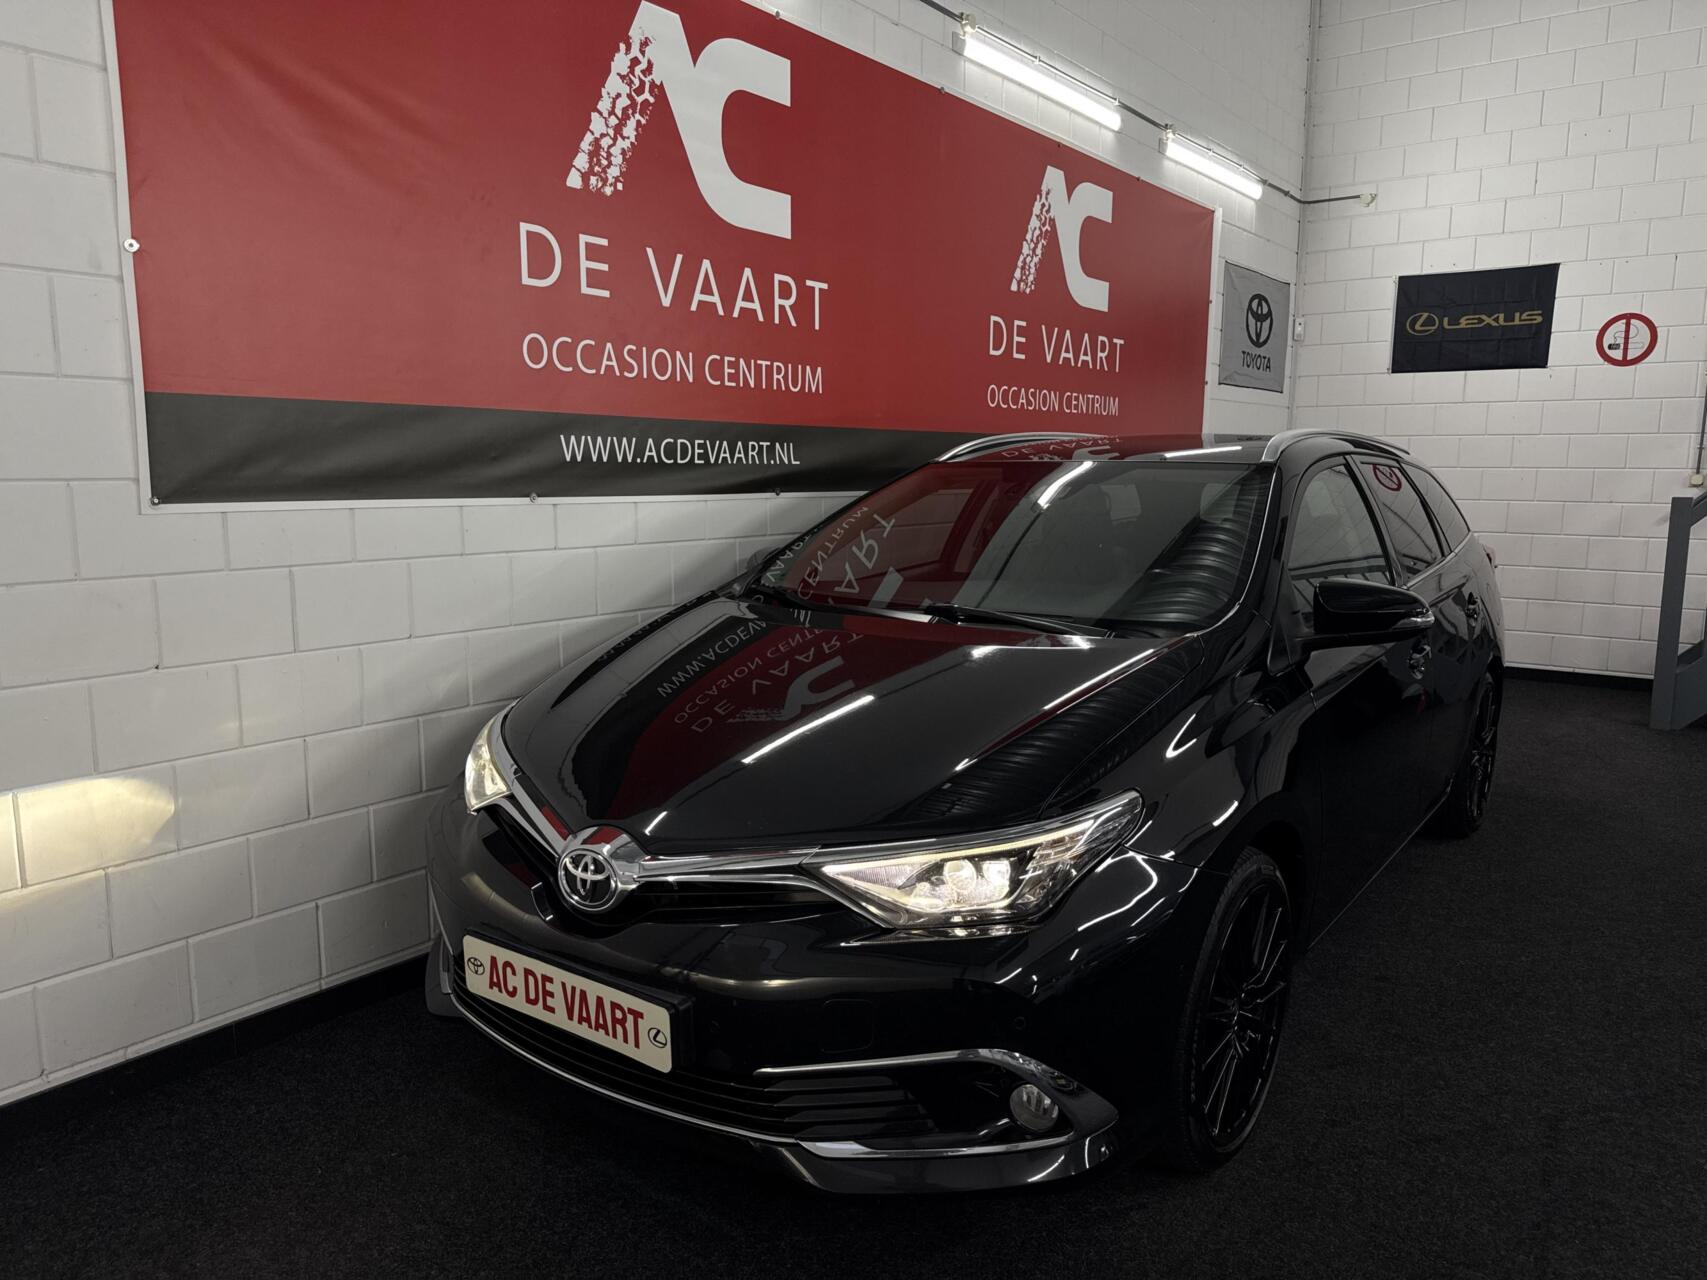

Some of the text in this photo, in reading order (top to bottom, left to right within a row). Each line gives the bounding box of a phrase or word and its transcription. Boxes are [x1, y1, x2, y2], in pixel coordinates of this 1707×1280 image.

[566, 0, 792, 240] AC
[1010, 165, 1113, 313] AC
[519, 221, 829, 331] DE VAART
[988, 315, 1125, 373] DE VAART
[1442, 310, 1544, 330] LEXUS
[522, 332, 823, 394] OCCASION CENTRUM
[1241, 350, 1272, 373] TOYOTA
[987, 384, 1119, 416] OCCASION CENTRUM
[560, 434, 800, 465] WWW.ACDEVAART.NL
[488, 955, 645, 1049] AC DE VAART
